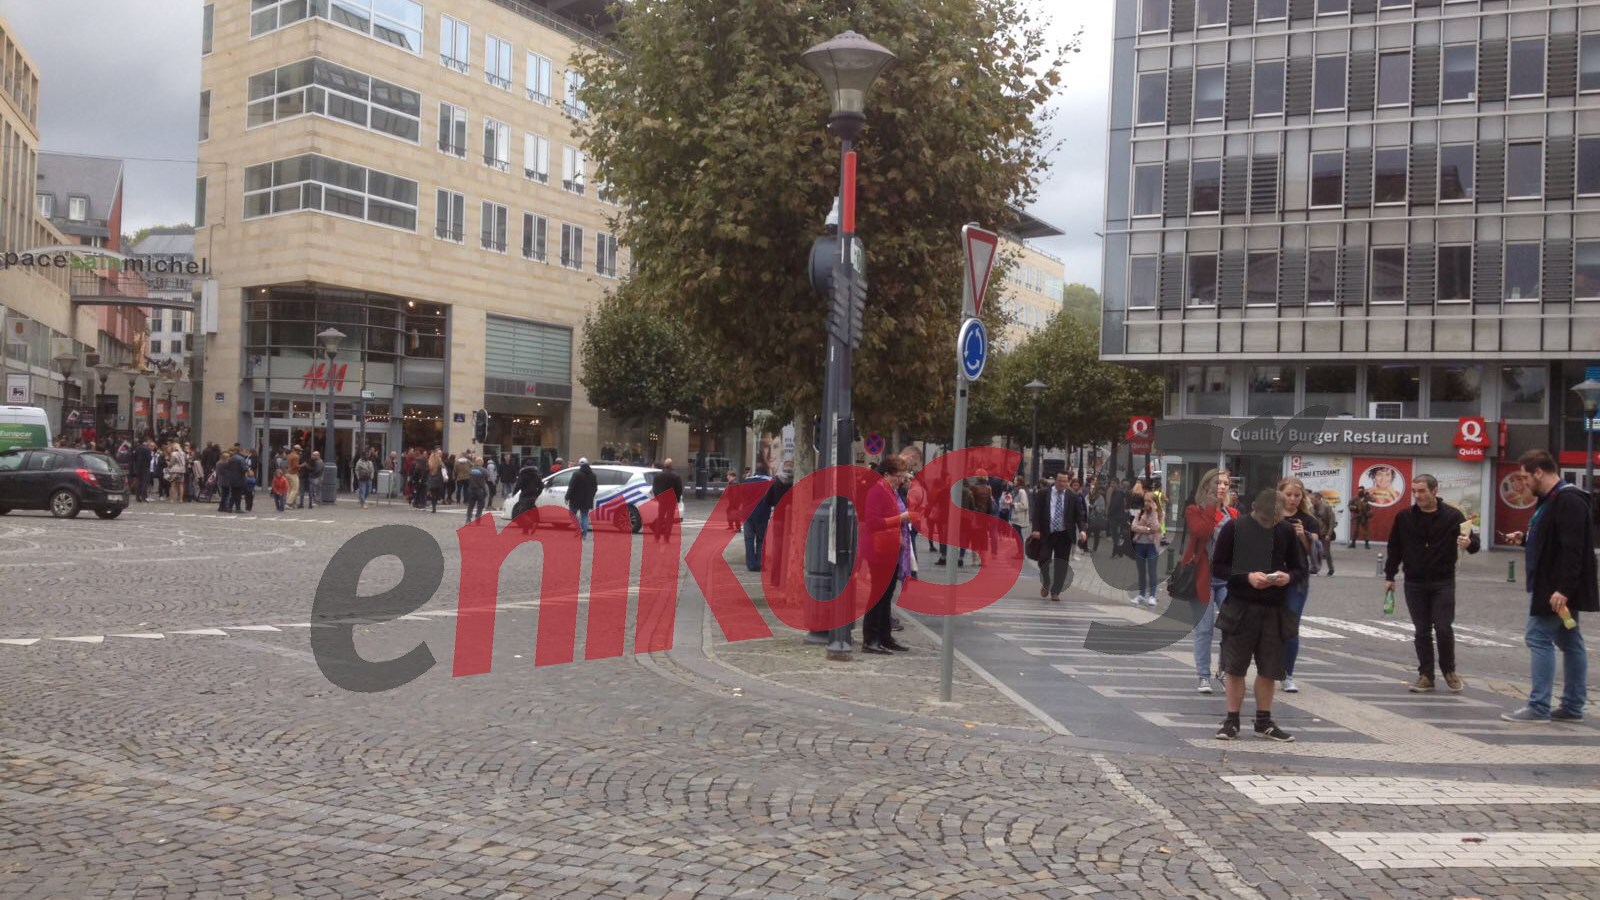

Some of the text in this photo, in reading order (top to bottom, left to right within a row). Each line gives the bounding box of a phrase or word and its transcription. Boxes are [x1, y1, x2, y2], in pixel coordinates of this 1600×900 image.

[1230, 427, 1430, 446] Quality Burger Restaurant
[1461, 421, 1483, 442] Q
[1459, 448, 1482, 456] Quick
[1313, 469, 1341, 477] ETUDIANT
